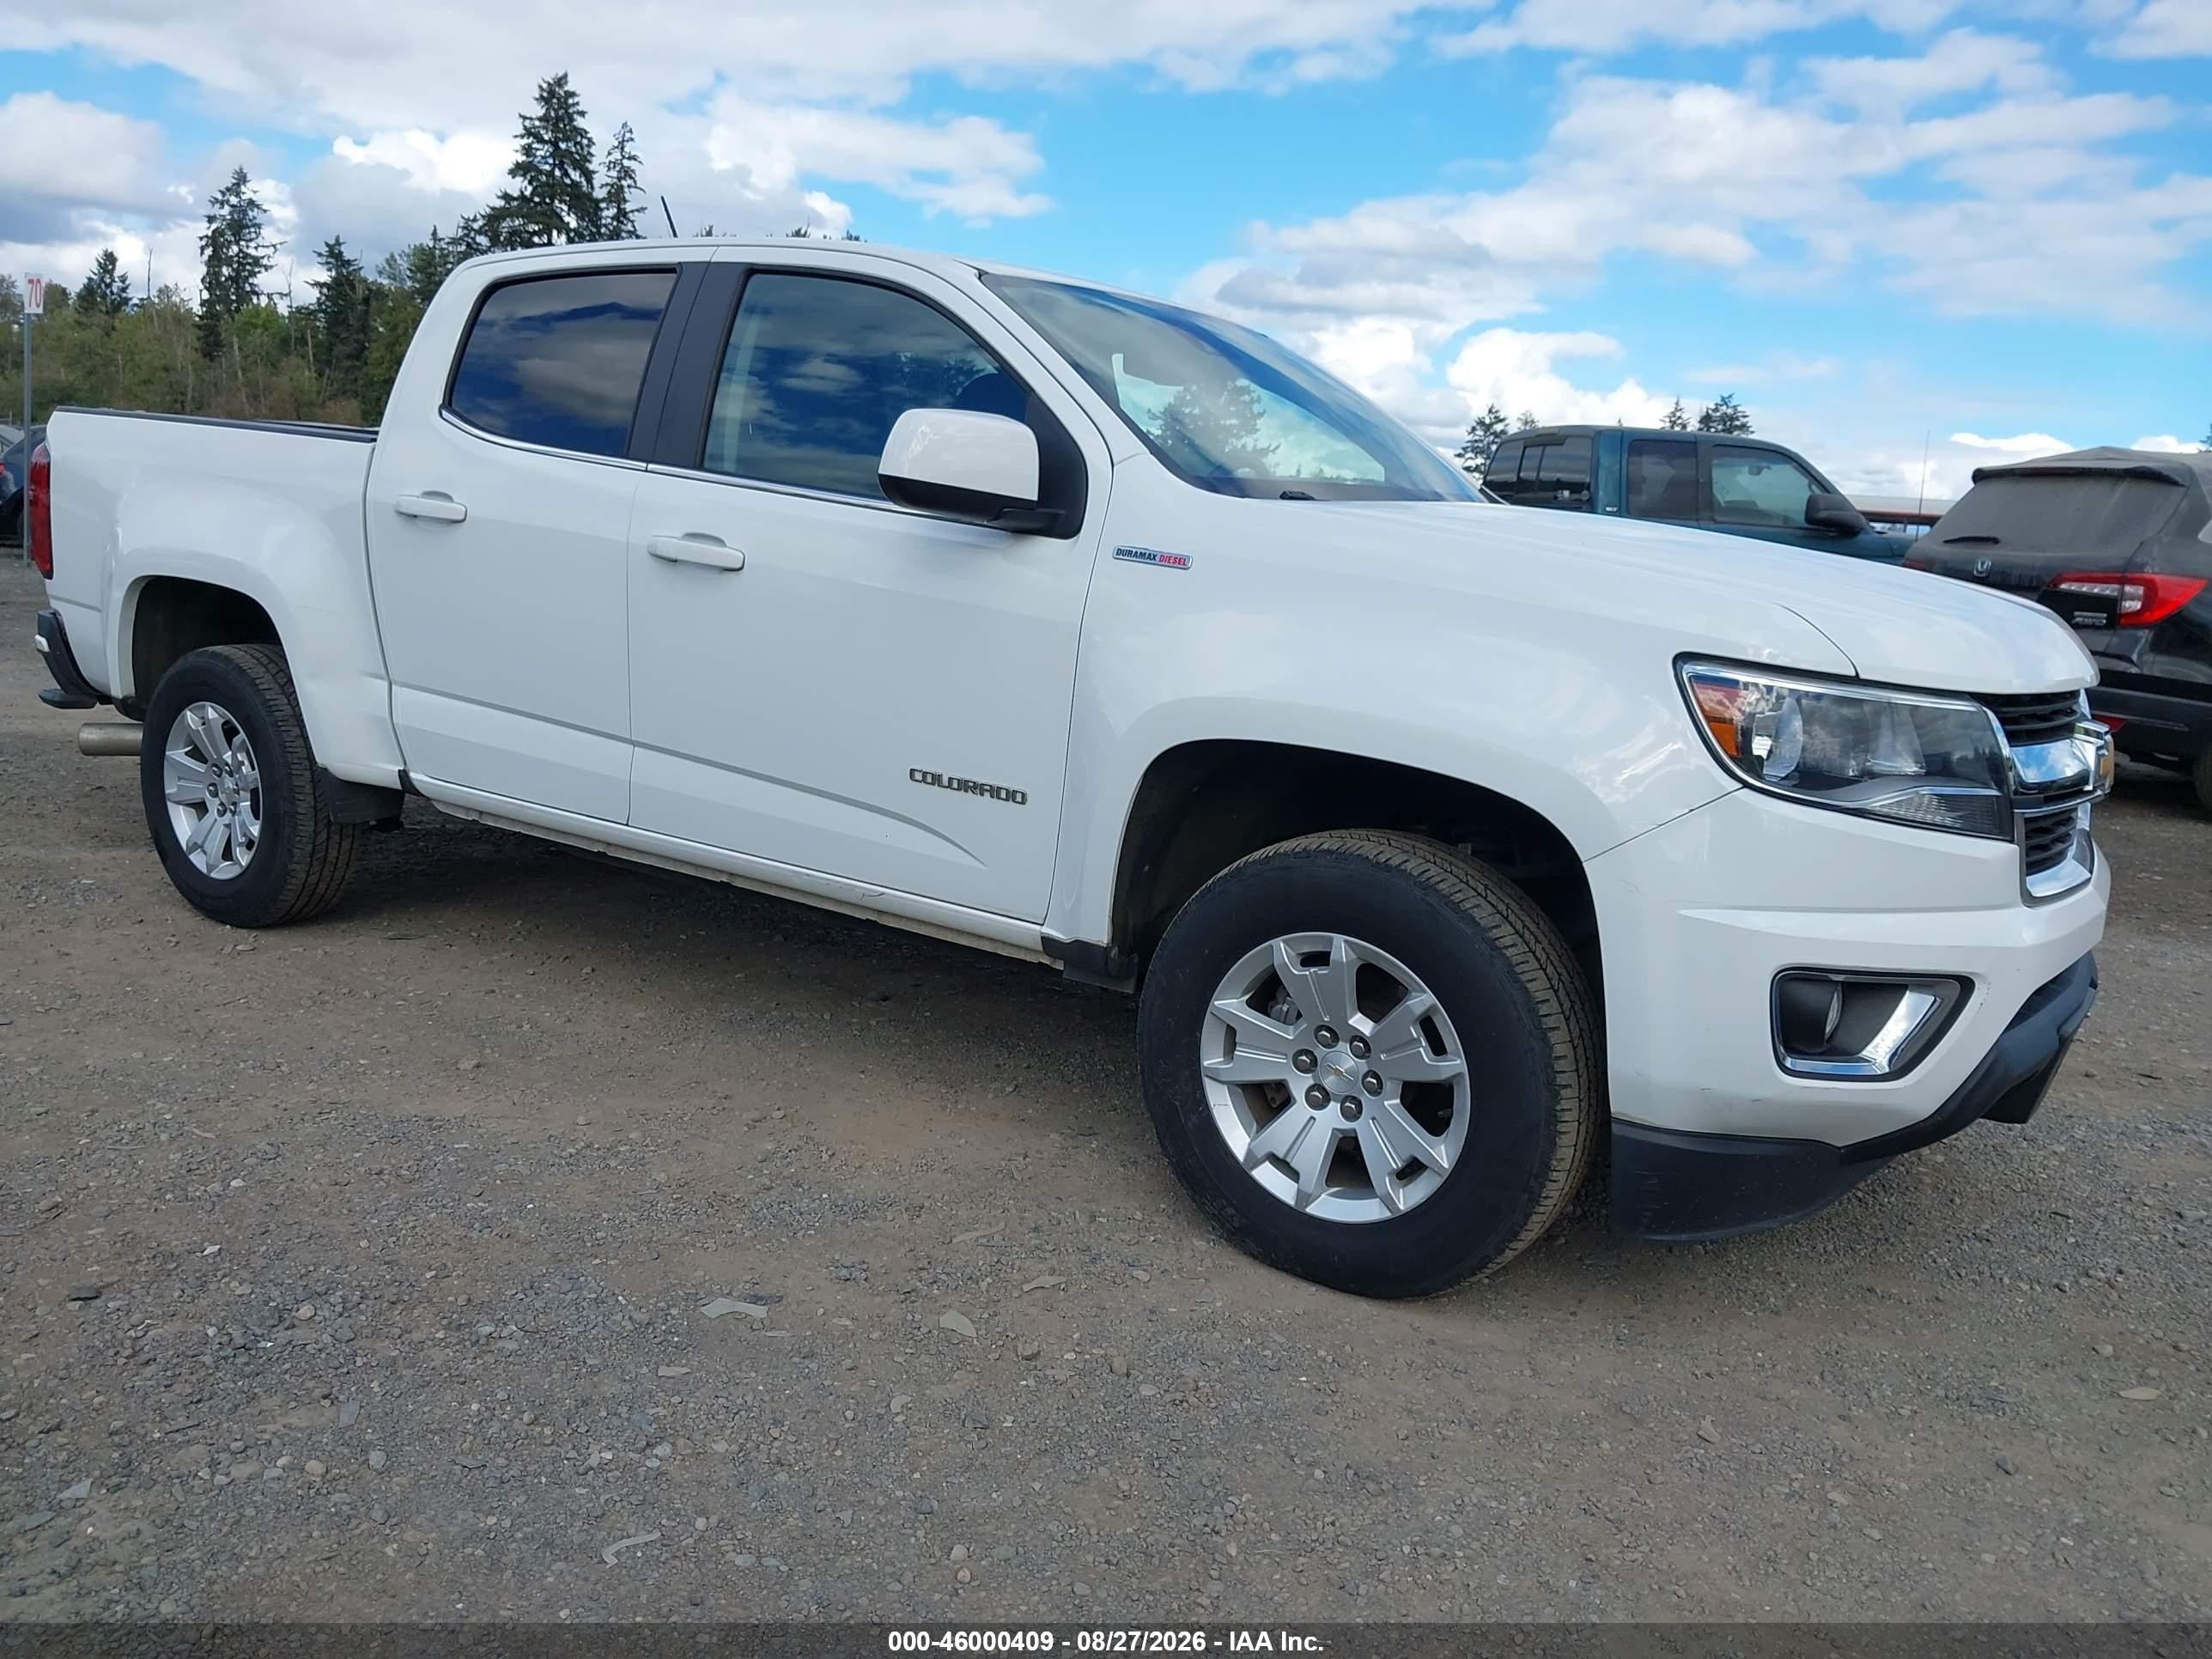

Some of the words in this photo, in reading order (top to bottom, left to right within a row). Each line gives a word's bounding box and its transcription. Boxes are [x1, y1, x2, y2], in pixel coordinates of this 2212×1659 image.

[27, 278, 42, 308] 70
[1115, 548, 1158, 562] DURAMAX
[1158, 554, 1187, 567] DIESEL
[909, 768, 1028, 805] COLORADO
